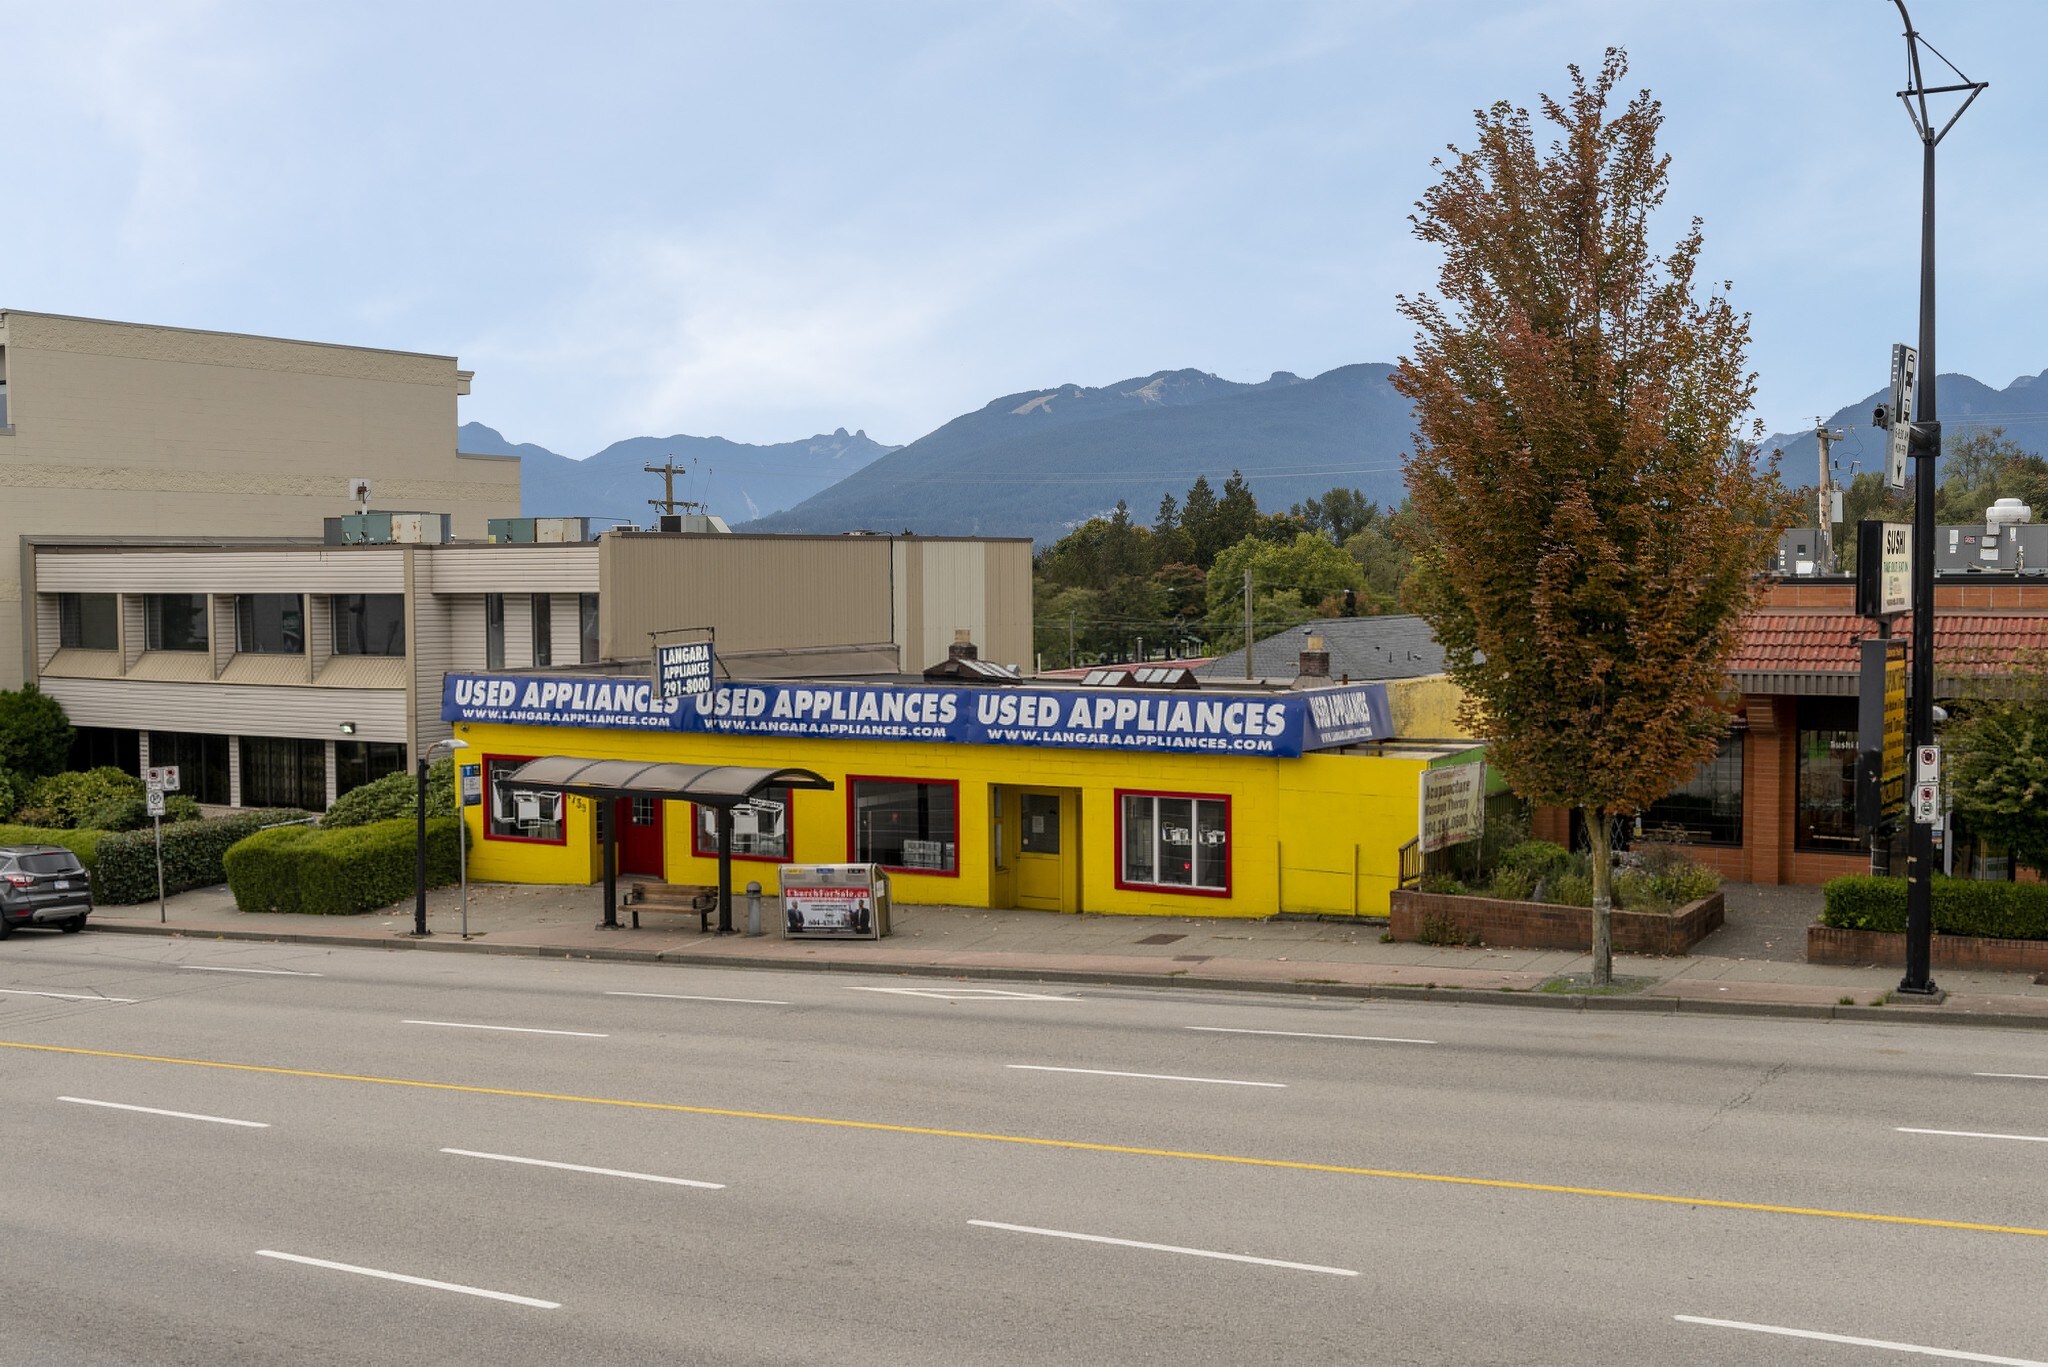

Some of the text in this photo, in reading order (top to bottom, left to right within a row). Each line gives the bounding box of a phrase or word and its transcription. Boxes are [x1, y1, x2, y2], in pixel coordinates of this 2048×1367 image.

[1886, 529, 1906, 555] SUSHI
[663, 645, 709, 666] LANGARA
[663, 662, 710, 680] APPLIANCES
[455, 679, 516, 706] USED
[664, 676, 711, 698] 291-8000
[695, 687, 958, 724] USED APPLIANCES
[977, 694, 1060, 727] USED
[1067, 697, 1286, 736] APPLIANCES
[462, 708, 670, 727] WWW.LANGARAAPPLIANCES.COM
[704, 718, 946, 738] WWW.LANGARAAPPLIANCES.COM
[987, 728, 1273, 751] WWW.LANGARAAPPLIANCES.COM
